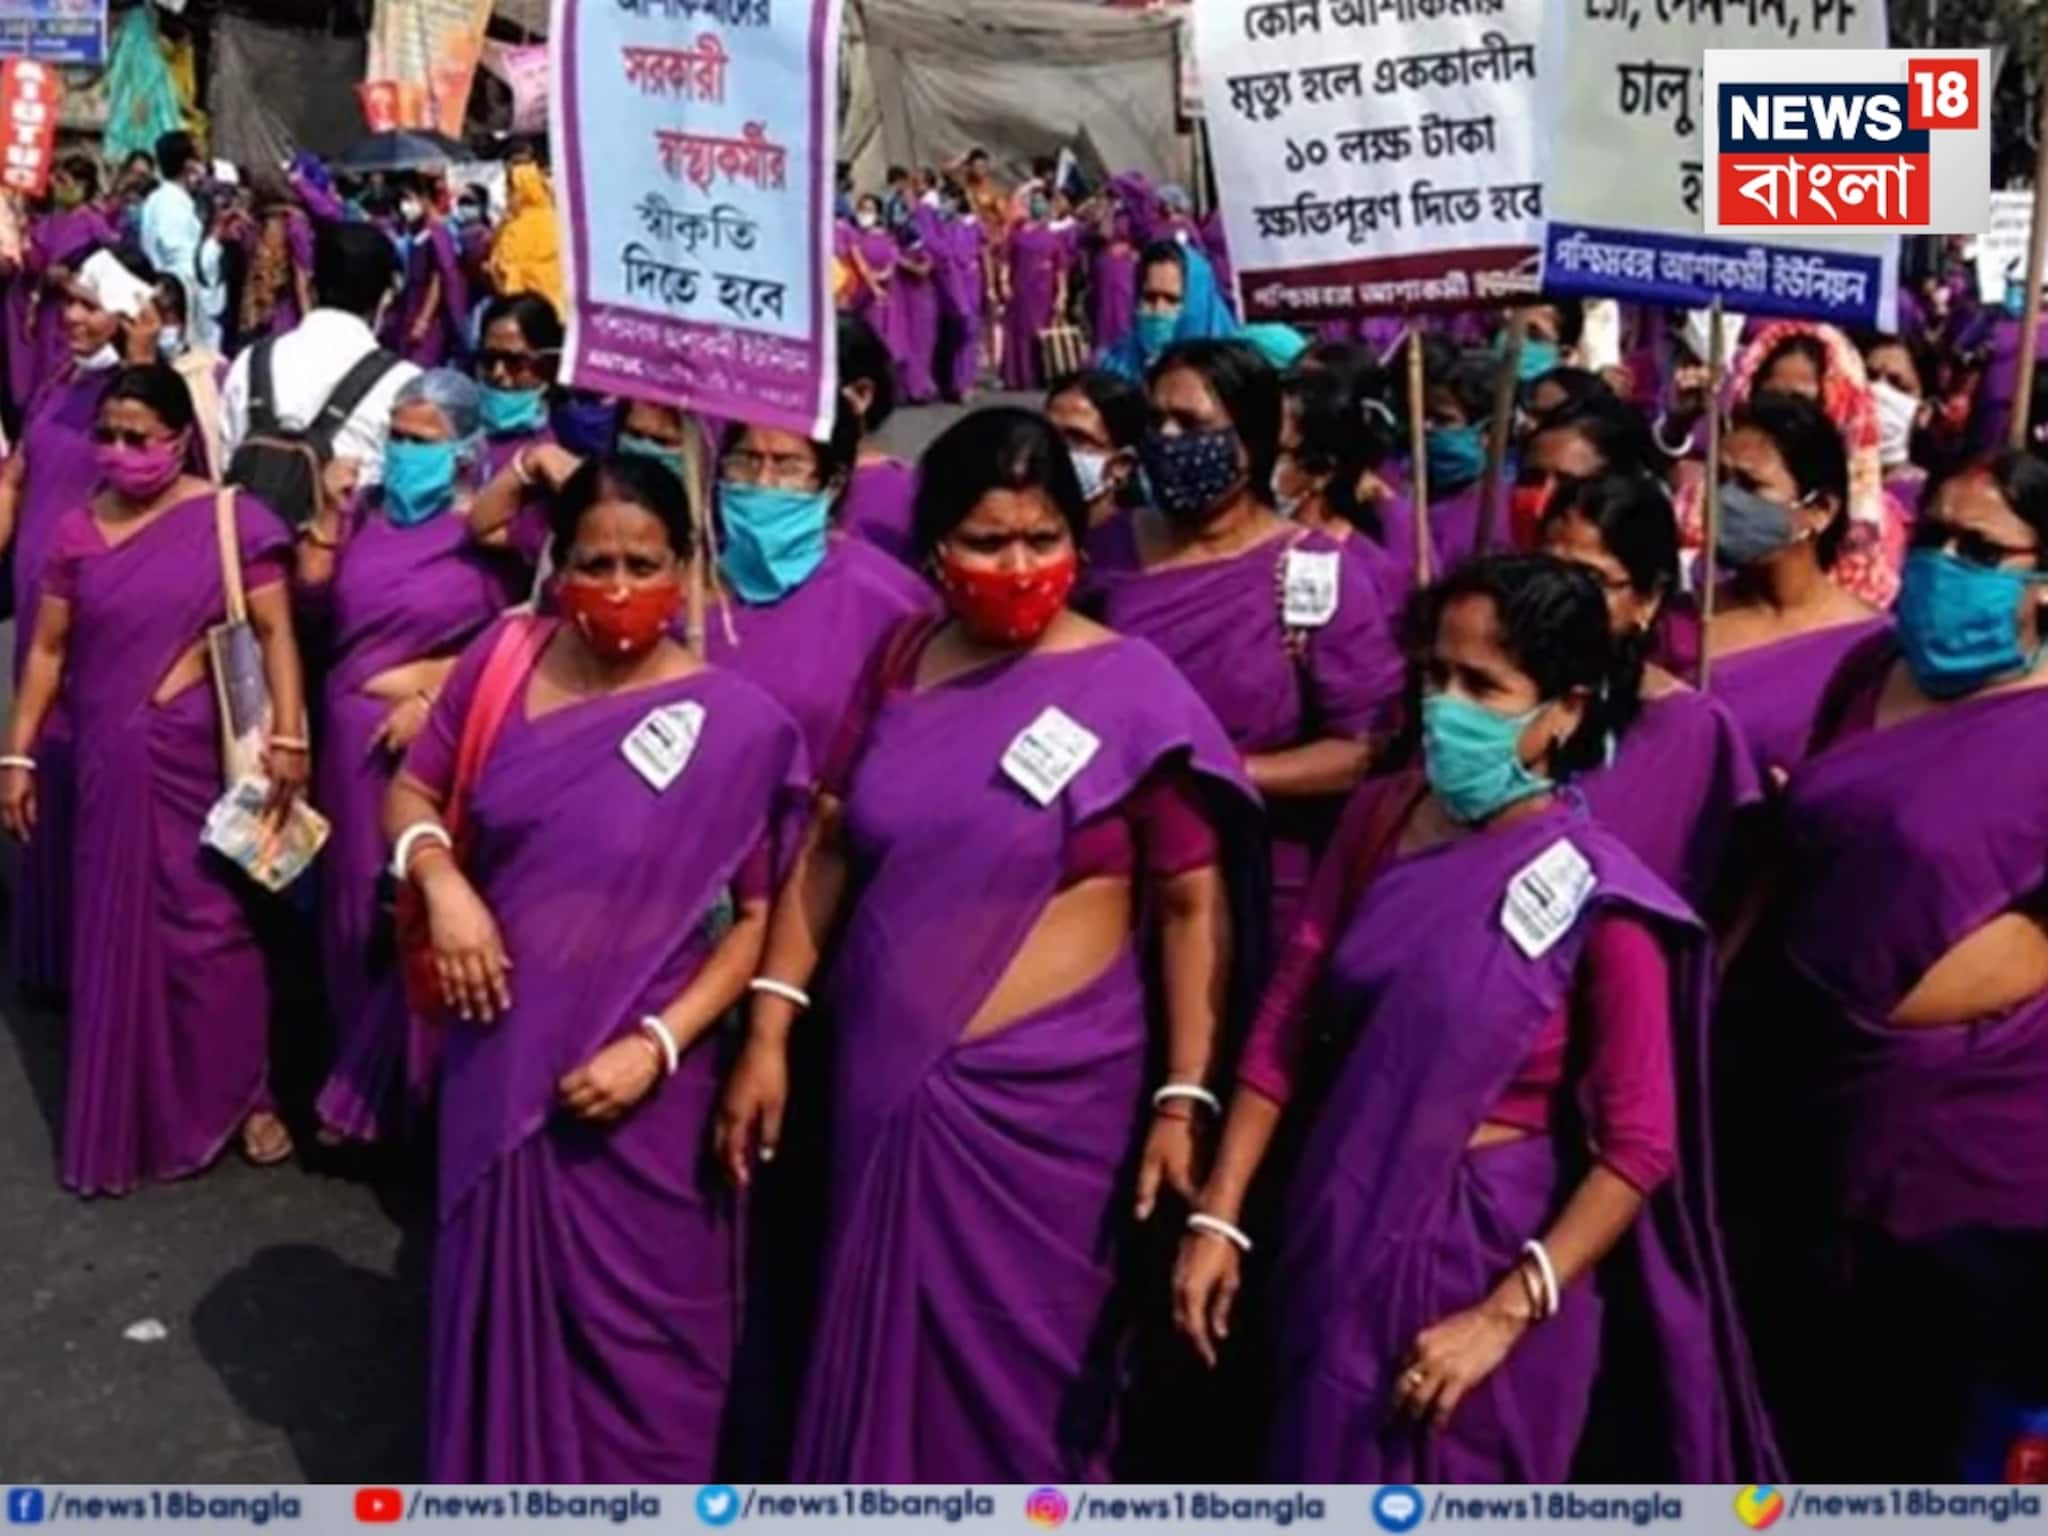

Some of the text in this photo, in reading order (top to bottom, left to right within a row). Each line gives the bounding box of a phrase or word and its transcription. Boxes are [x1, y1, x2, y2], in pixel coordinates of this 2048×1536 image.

[622, 32, 729, 104] সরকারী
[1227, 31, 1537, 121] মৃত্যু হলে এককালীন
[1615, 58, 1696, 138] চালু
[1286, 113, 1495, 172] ১০ লক্ষ টাকা
[1253, 180, 1543, 244] ক্ষতিপূরণ দিতে হবে
[621, 243, 787, 320] দিতে হবে
